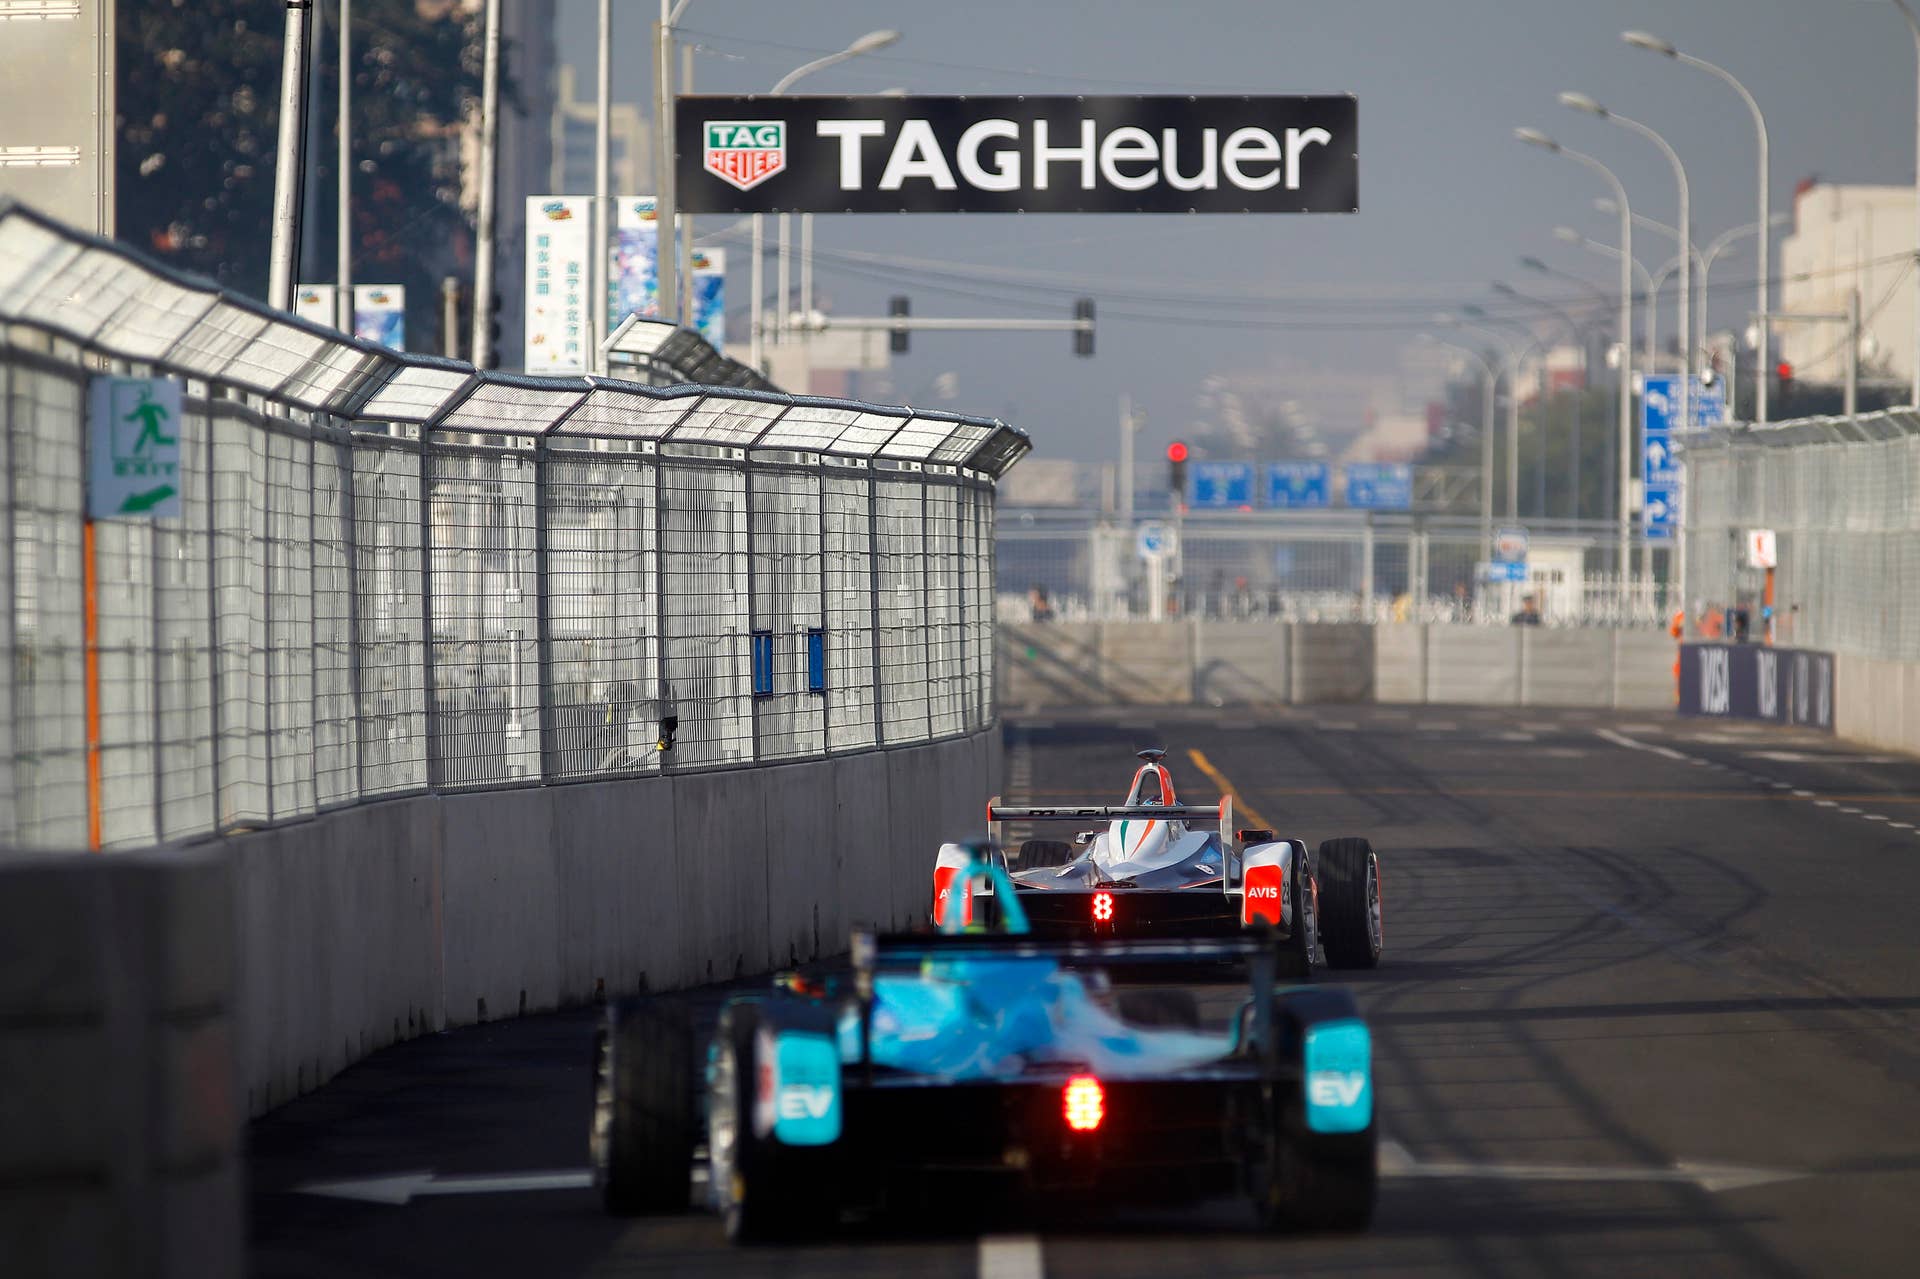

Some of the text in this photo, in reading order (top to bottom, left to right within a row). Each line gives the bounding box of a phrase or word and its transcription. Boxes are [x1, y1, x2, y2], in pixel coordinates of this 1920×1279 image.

[711, 126, 778, 147] TAG
[710, 151, 780, 182] HEUER
[113, 460, 176, 476] EXIT
[1248, 887, 1278, 899] AVIS
